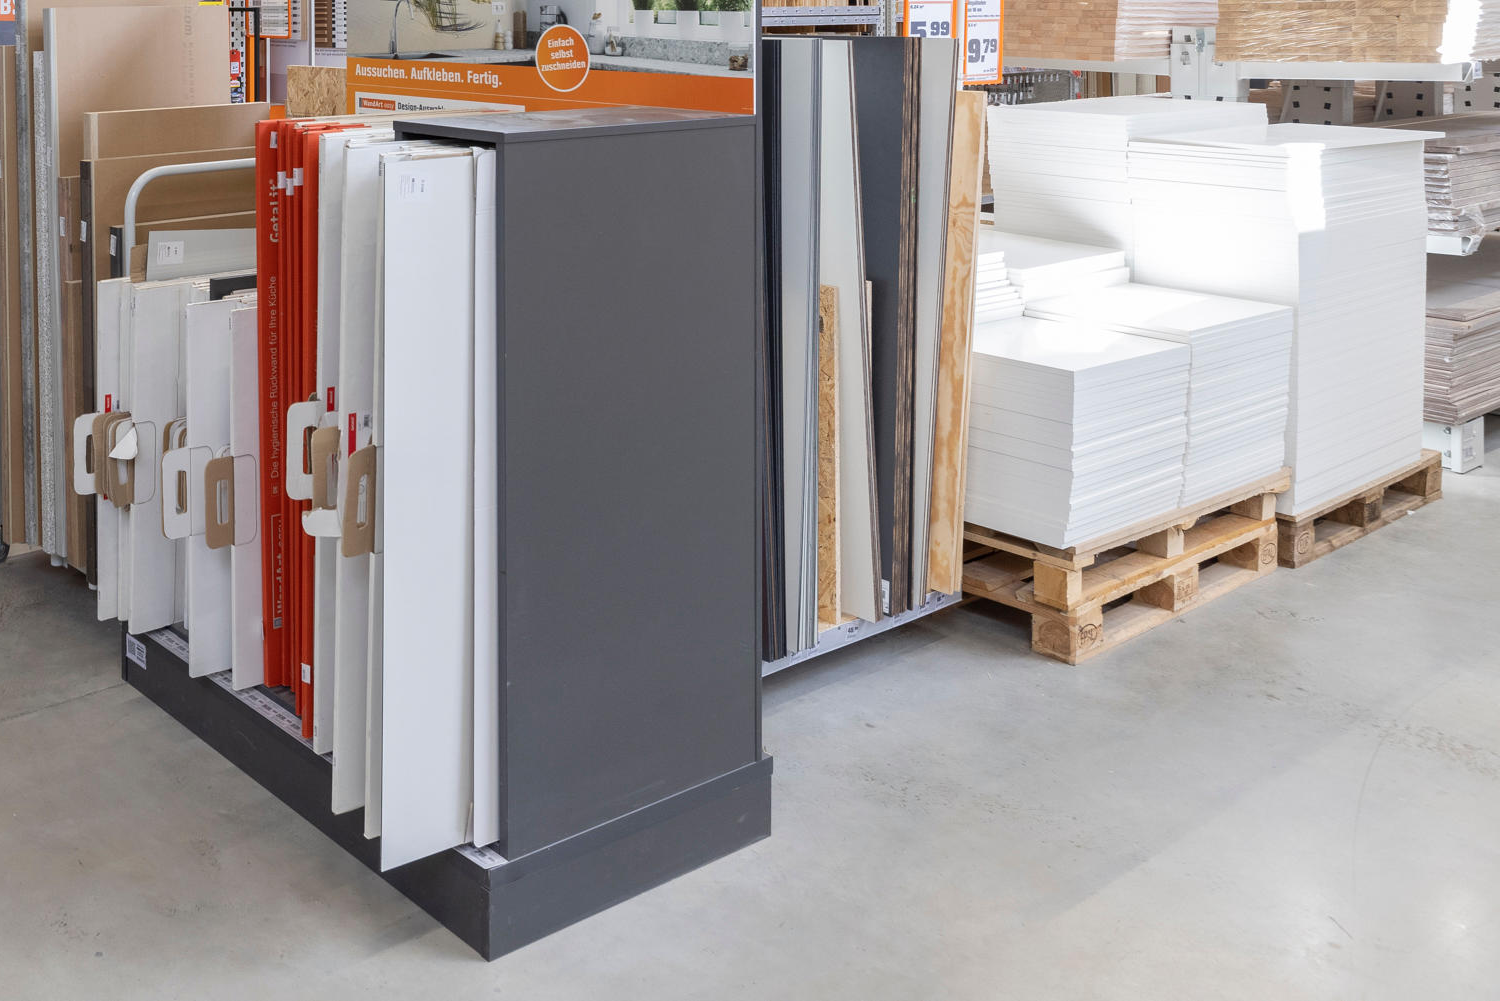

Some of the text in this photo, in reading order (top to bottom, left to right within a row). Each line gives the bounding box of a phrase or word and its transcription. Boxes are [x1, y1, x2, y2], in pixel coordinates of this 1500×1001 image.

[548, 37, 574, 48] Einfach
[968, 39, 998, 63] 9,79
[551, 50, 573, 59] selbst
[355, 63, 502, 88] Aussuchen. Aufkleben. Fertig.
[541, 60, 586, 71] zuschneiden
[268, 276, 277, 307] Küche
[268, 309, 277, 328] Ihre
[268, 328, 277, 345] für
[269, 348, 278, 399] Rückwand
[270, 401, 280, 456] hygienische
[270, 458, 279, 479] Die
